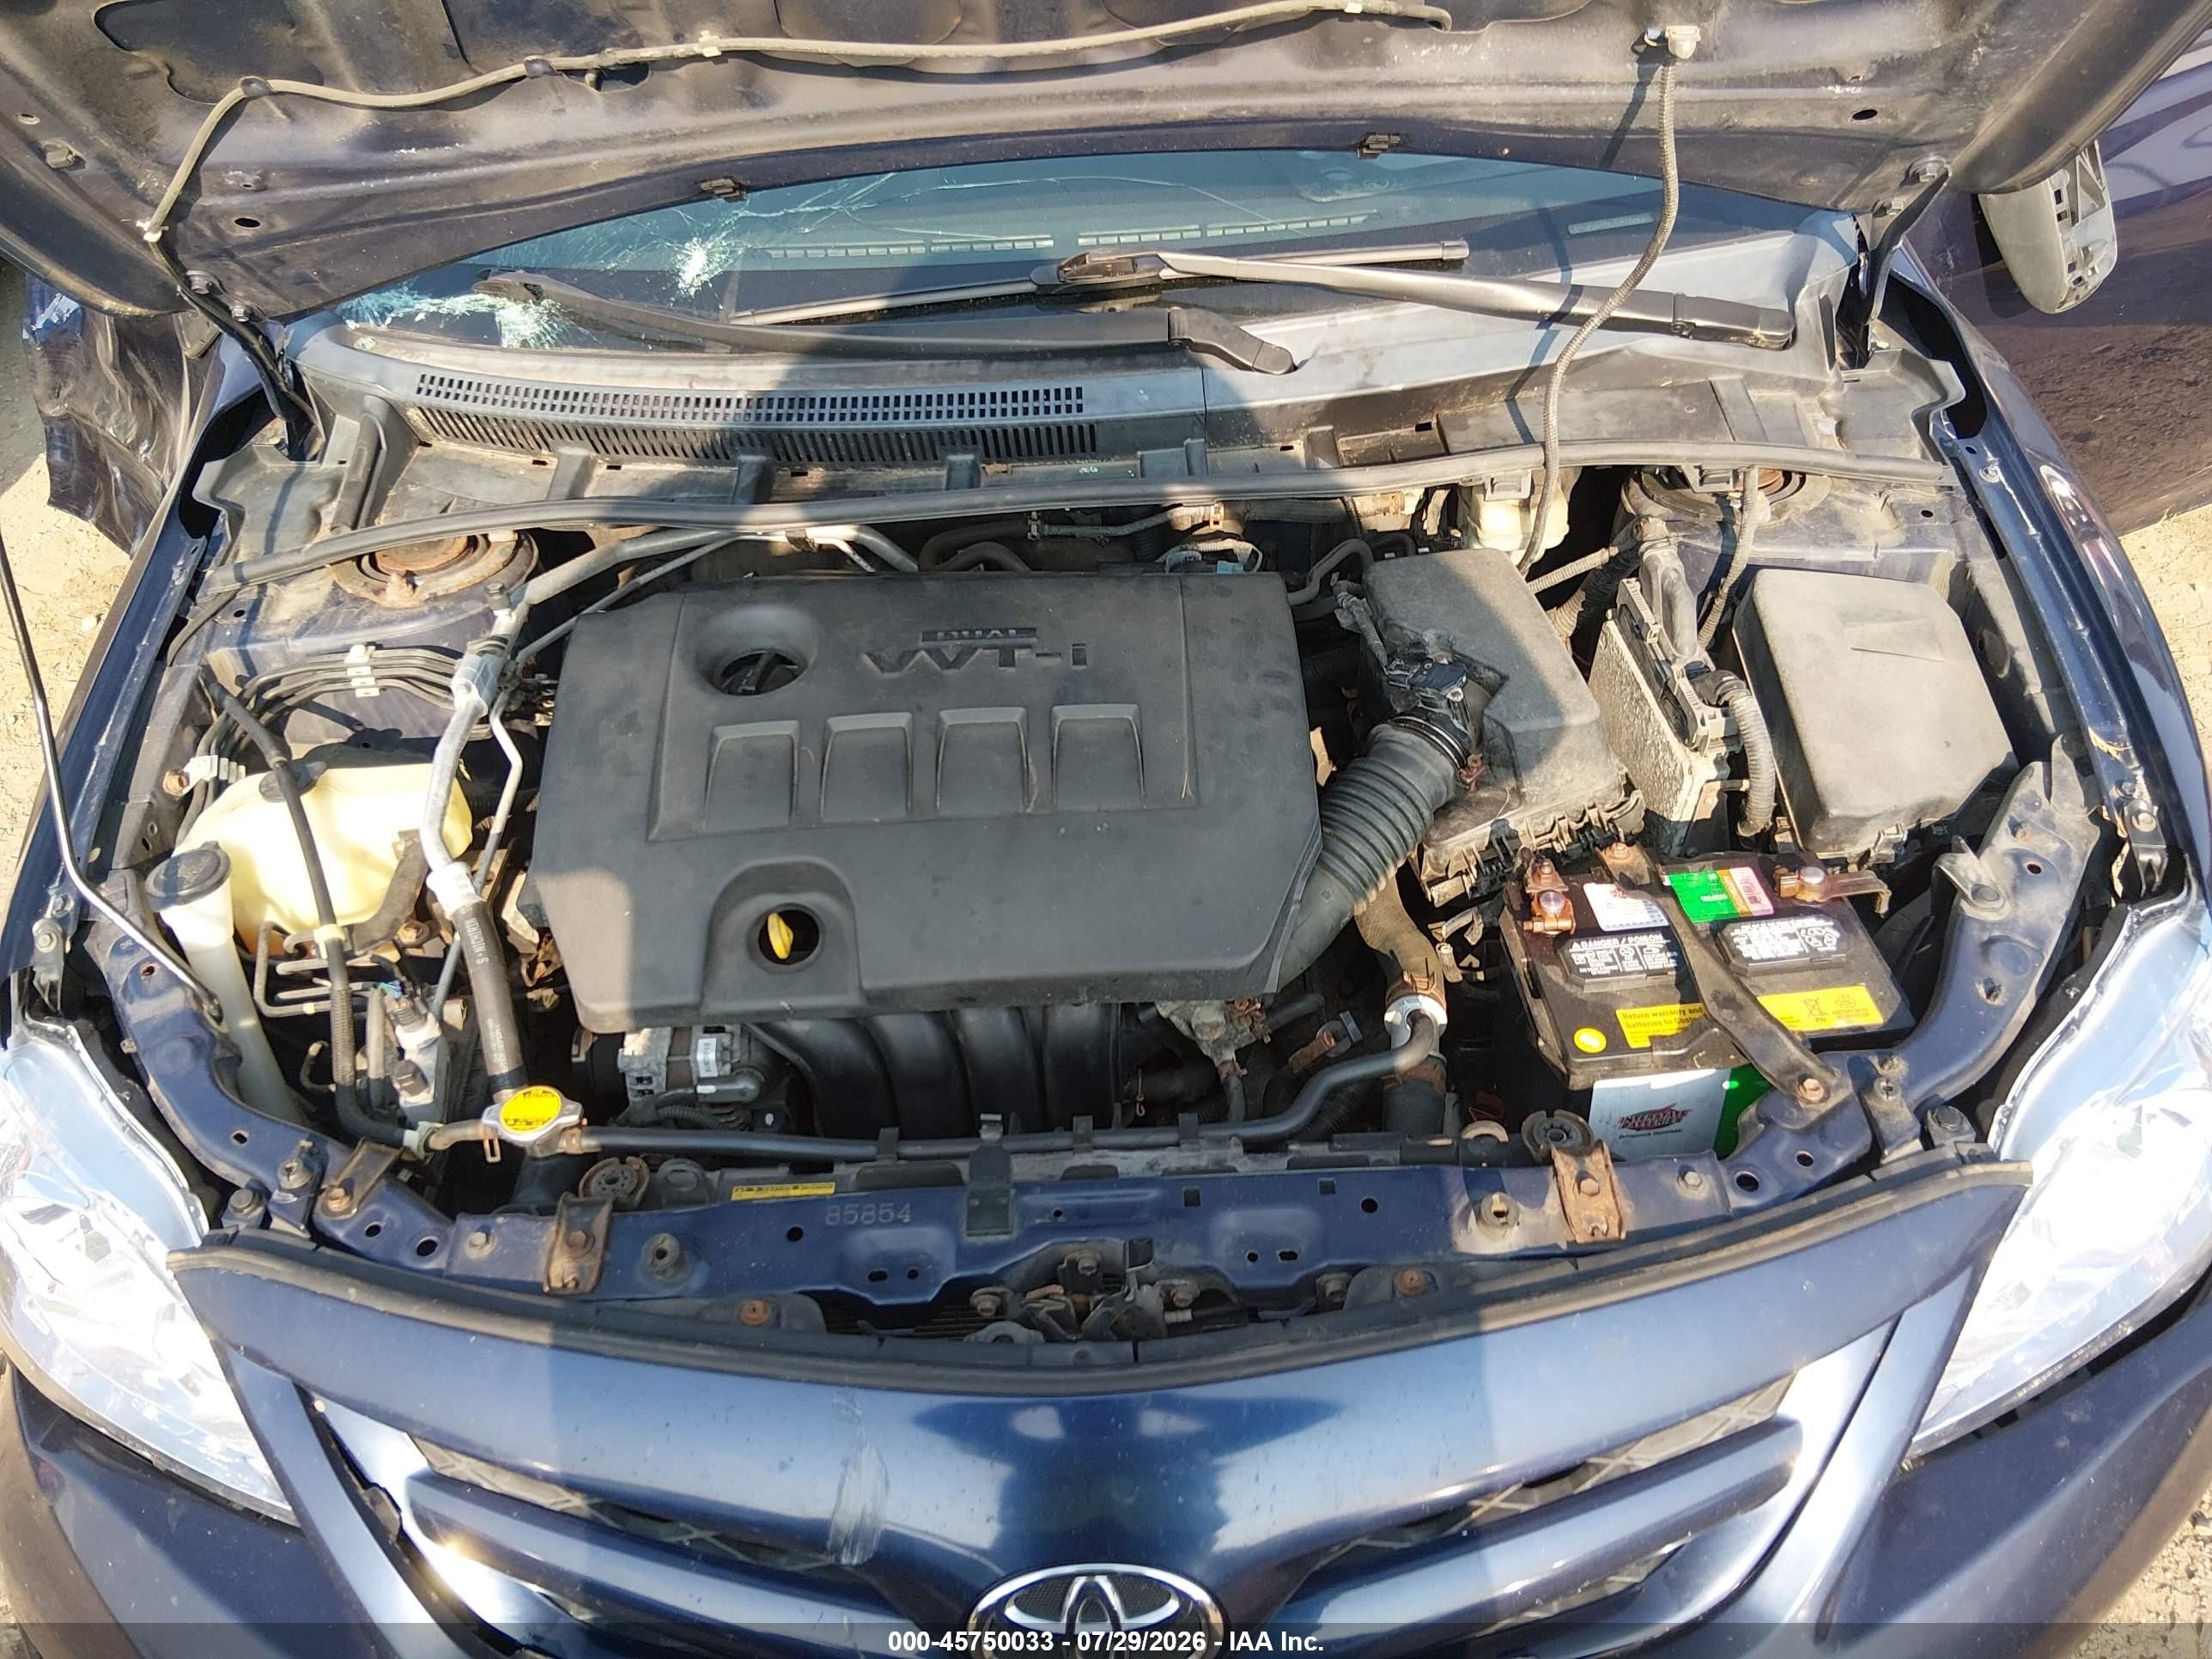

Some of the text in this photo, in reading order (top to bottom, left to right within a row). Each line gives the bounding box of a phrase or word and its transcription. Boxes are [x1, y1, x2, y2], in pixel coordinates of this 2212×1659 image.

[936, 629, 1019, 640] DUAL
[864, 642, 1087, 674] VVT-i
[1581, 937, 1620, 948] DANGER
[1627, 933, 1664, 944] POISON
[1688, 1006, 1703, 1014] and
[825, 1202, 911, 1226] 85854
